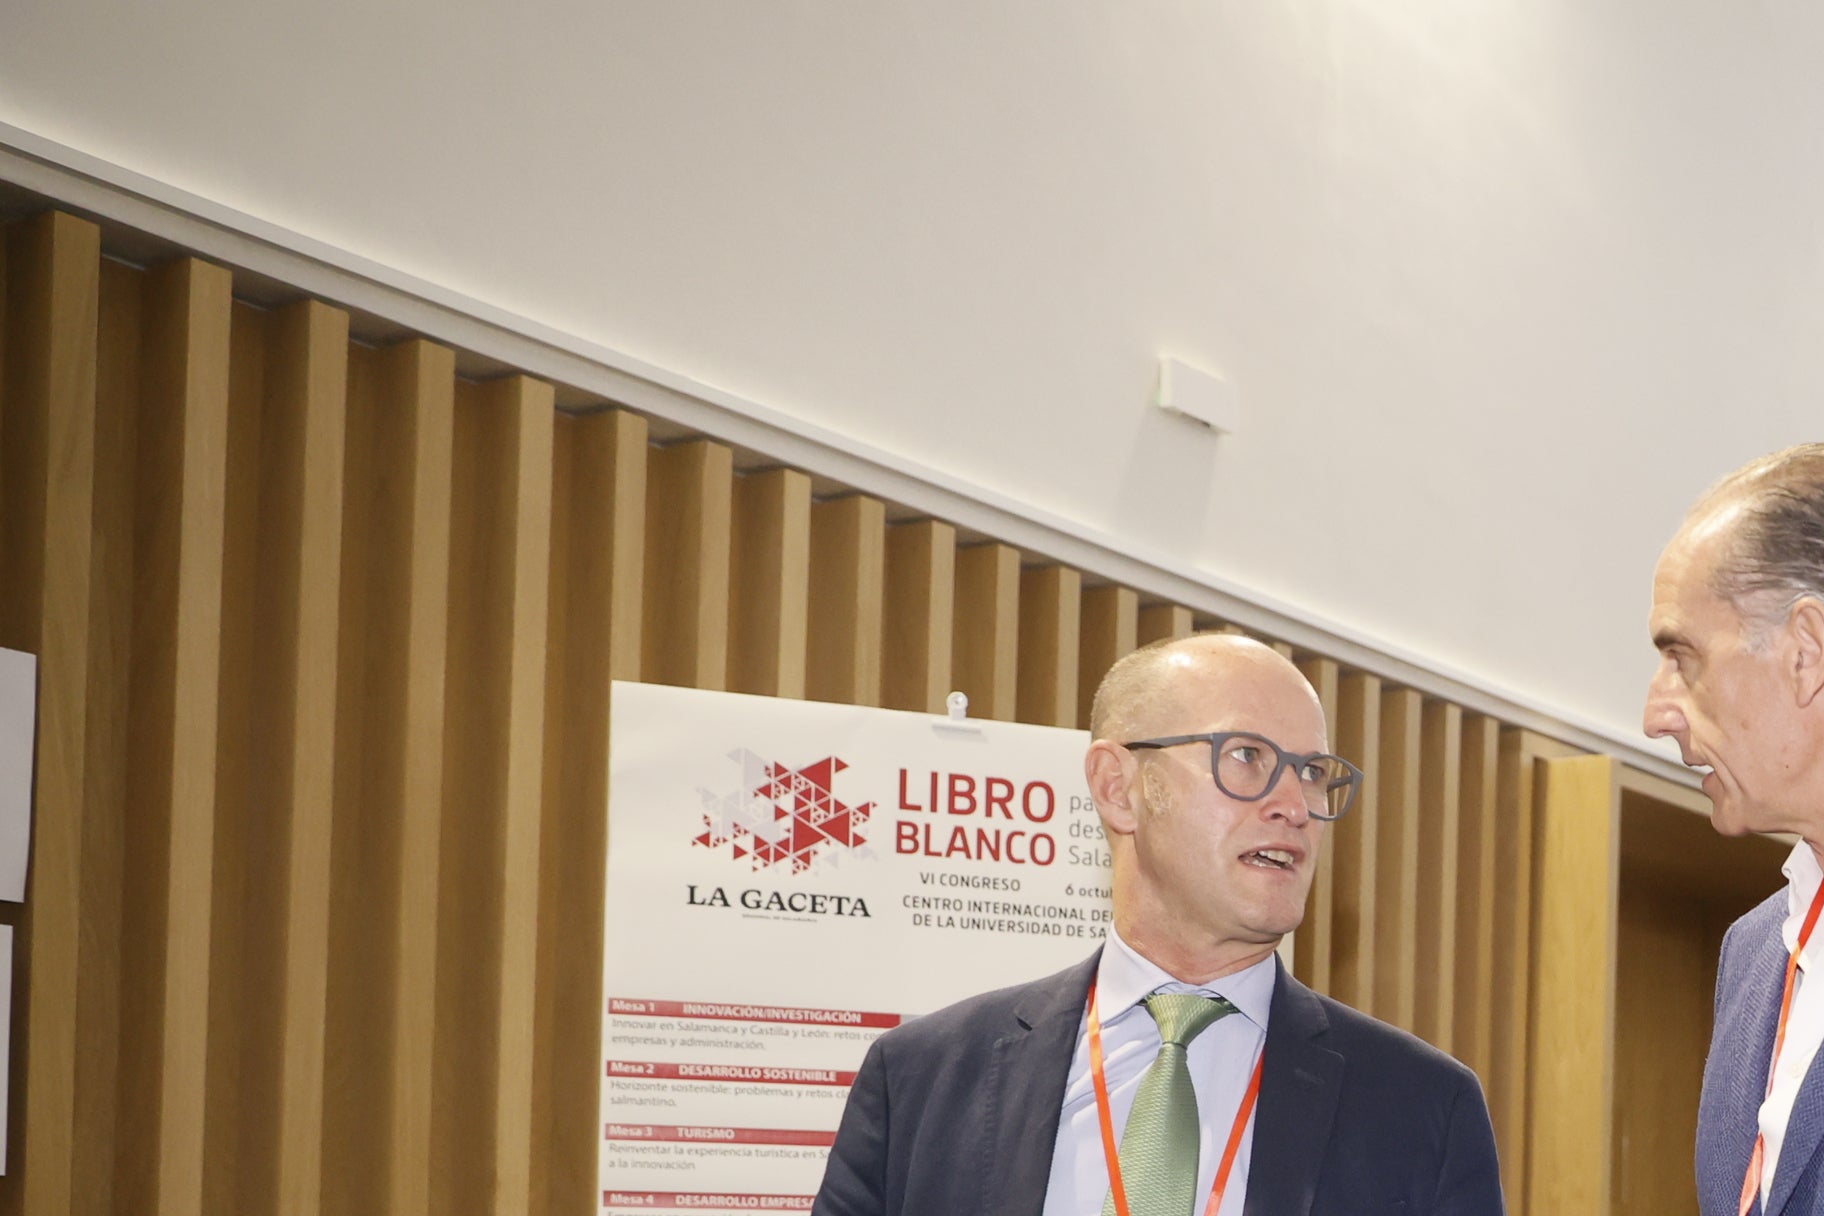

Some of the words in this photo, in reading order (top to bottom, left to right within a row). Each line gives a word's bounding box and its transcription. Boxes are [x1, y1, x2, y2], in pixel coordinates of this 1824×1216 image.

[899, 768, 1055, 823] LIBRO
[896, 820, 1056, 866] BLANCO
[920, 872, 935, 885] VI
[939, 873, 1021, 892] CONGRESO
[1065, 883, 1073, 896] 6
[686, 885, 731, 907] LA
[740, 889, 871, 917] GACETA
[902, 895, 963, 911] CENTRO
[968, 900, 1085, 921] INTERNACIONAL
[913, 913, 932, 926] DE
[937, 915, 955, 928] LA
[960, 917, 1061, 936] UNIVERSIDAD
[1066, 925, 1084, 938] DE
[612, 1000, 646, 1012] Mesa
[649, 1002, 655, 1013] 1
[683, 1002, 861, 1023] INNOVACIÓN/INVESTIGACIÓN
[612, 1019, 656, 1029] Innovar
[678, 1021, 738, 1034] Salamanca
[742, 1027, 747, 1035] y
[750, 1025, 789, 1036] Castilla
[792, 1029, 797, 1037] y
[834, 1031, 860, 1040] retos
[612, 1035, 667, 1046] empresas
[670, 1039, 676, 1048] y
[680, 1038, 765, 1050] administración.
[610, 1062, 644, 1074] Mesa
[646, 1063, 654, 1074] 2
[679, 1064, 761, 1079] DESARROLLO
[763, 1068, 836, 1081] SOSTENIBLE
[610, 1080, 667, 1091] Horizonte
[671, 1083, 731, 1094] sostenible:
[734, 1086, 793, 1098] problemas
[796, 1090, 801, 1098] y
[806, 1090, 832, 1098] retos
[610, 1125, 642, 1136] Mesa
[645, 1126, 653, 1136] 3
[677, 1127, 735, 1139] TURISMO
[610, 1143, 670, 1153] Reinventar
[674, 1146, 684, 1154] la
[687, 1147, 752, 1158] experiencia
[619, 1159, 628, 1168] la
[631, 1160, 695, 1170] innovación
[610, 1193, 643, 1204] Mesa
[646, 1194, 653, 1204] 4
[675, 1195, 758, 1207] DESARROLLO
